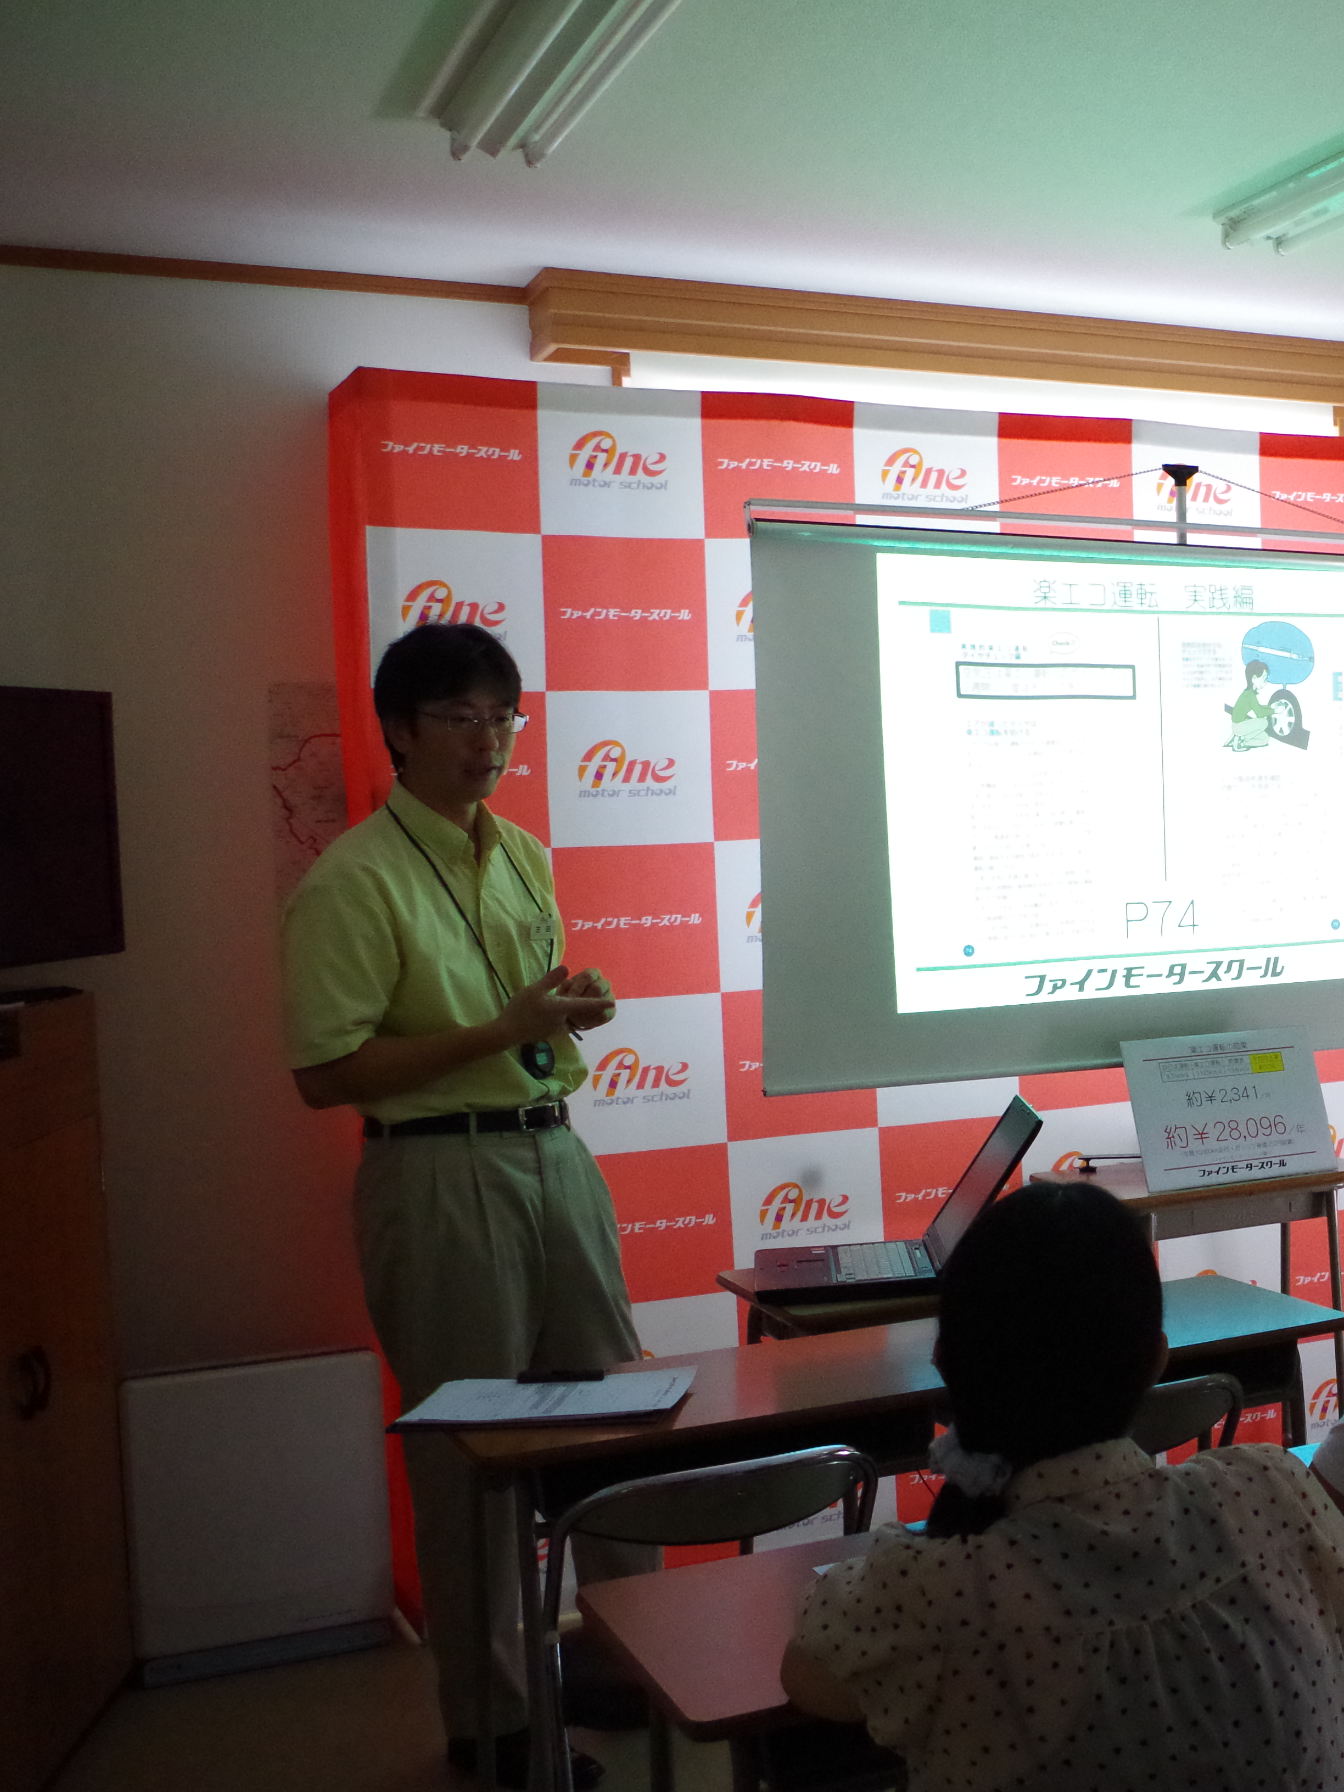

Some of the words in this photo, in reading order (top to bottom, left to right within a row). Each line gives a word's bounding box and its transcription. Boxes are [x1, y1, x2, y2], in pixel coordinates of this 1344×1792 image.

[380, 440, 522, 461] ファインモータースクール
[717, 458, 841, 475] ファインモータースクール
[1184, 583, 1255, 610] 実践編
[560, 606, 692, 622] ファインモータースクール
[571, 913, 702, 931] ファインモータースクール
[1125, 899, 1200, 939] P74
[1024, 956, 1285, 997] ファインモータースクール
[1199, 1159, 1287, 1178] ファインモータースクール
